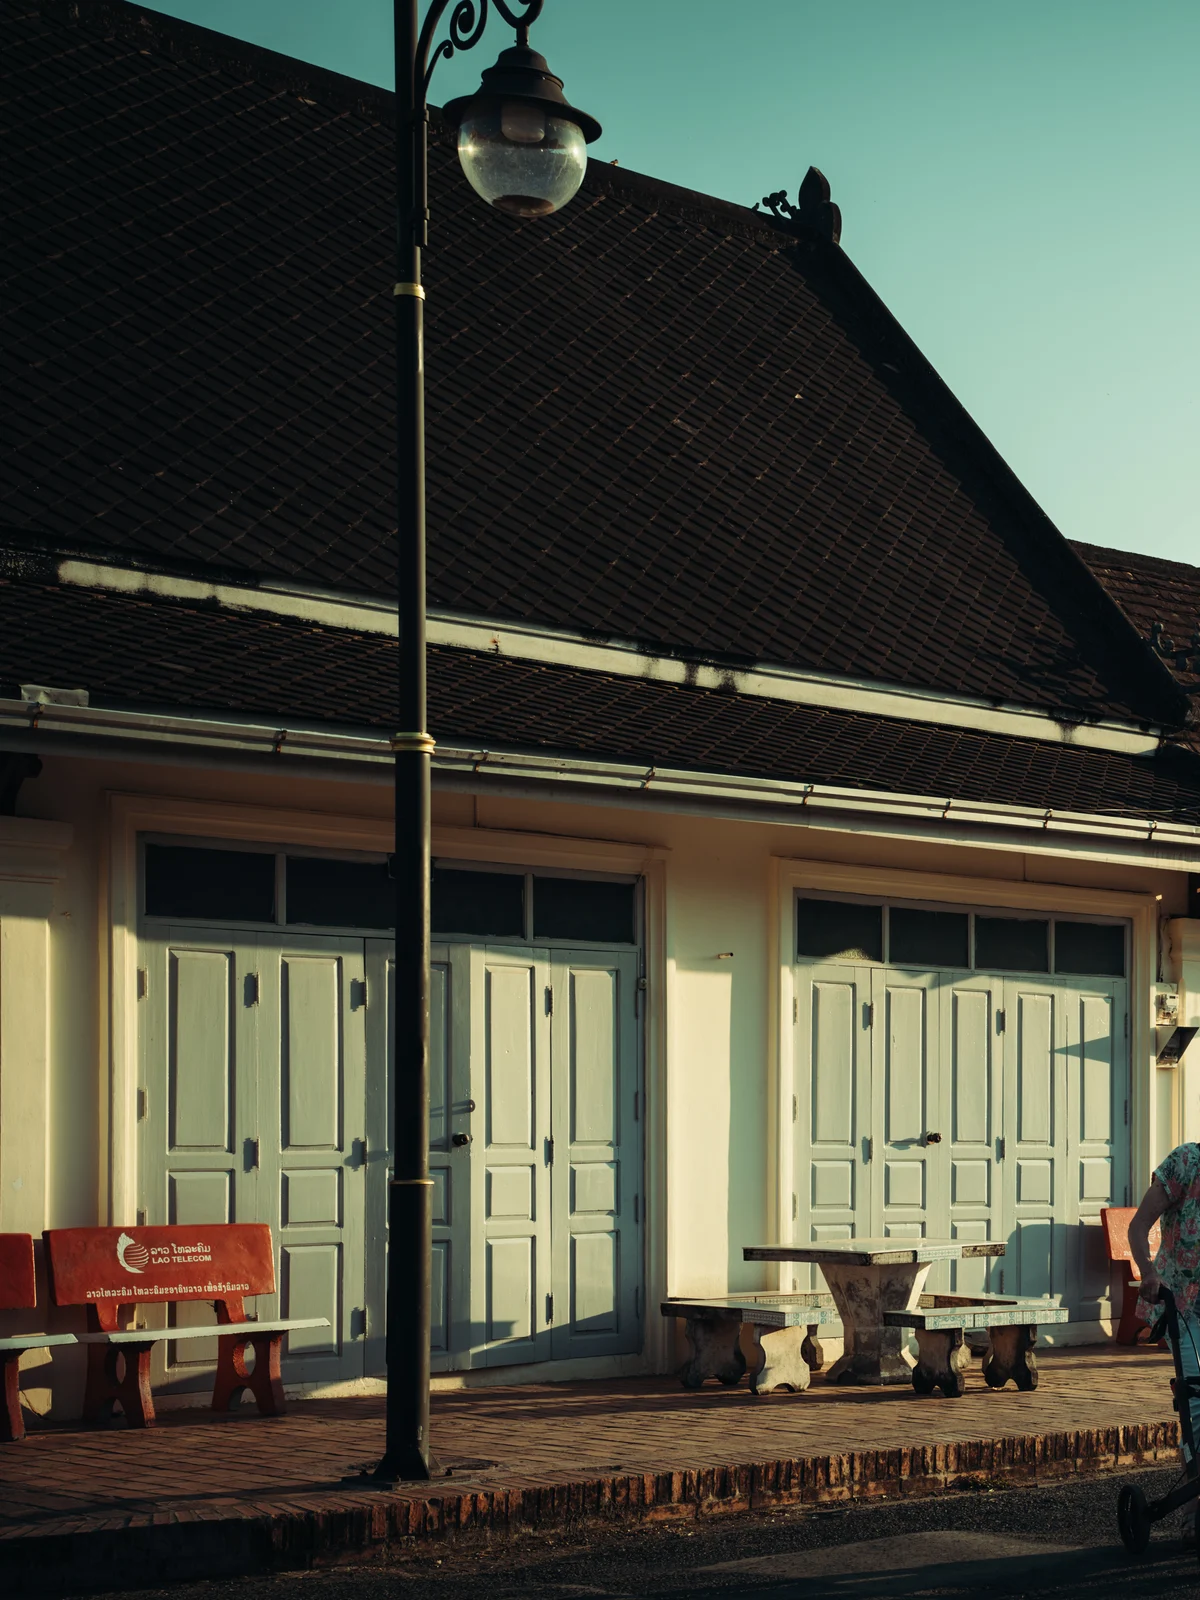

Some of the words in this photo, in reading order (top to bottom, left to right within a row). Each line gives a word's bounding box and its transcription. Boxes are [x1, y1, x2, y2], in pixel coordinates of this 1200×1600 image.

[150, 1247, 170, 1255] ລາວ
[152, 1256, 171, 1264] LAO
[171, 1254, 212, 1263] TELECOM
